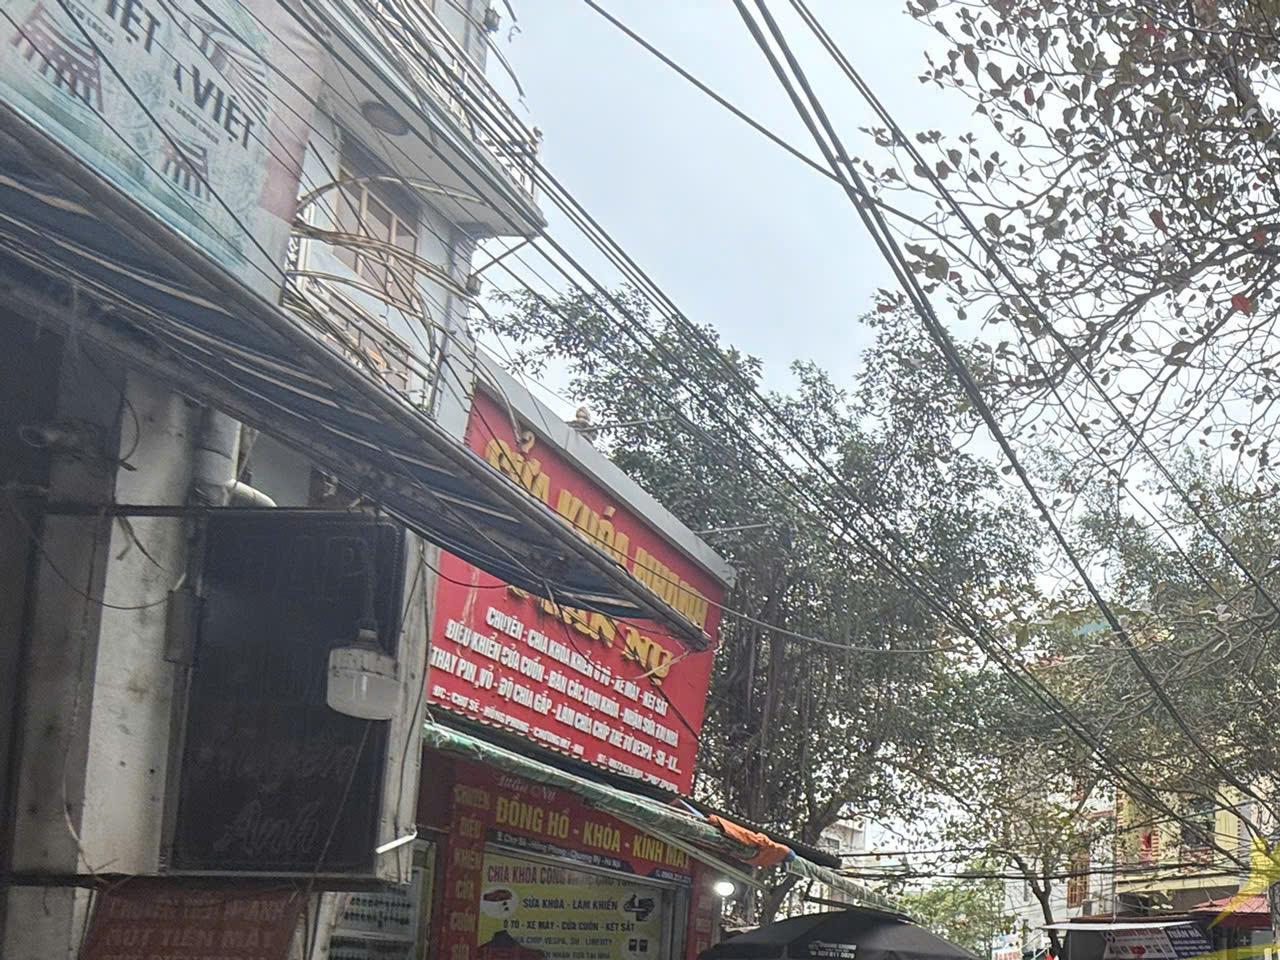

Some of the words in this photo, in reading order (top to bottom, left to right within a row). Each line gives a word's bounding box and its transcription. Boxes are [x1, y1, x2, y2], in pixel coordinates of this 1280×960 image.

[486, 606, 524, 640] CHUYÊN
[430, 646, 457, 674] THAY
[495, 794, 544, 835] ĐỒNG
[547, 808, 570, 839] HỒ
[583, 821, 621, 853] KHÓA
[632, 832, 663, 861] KÍNH
[512, 865, 538, 883] KHÓA
[522, 895, 541, 909] SỬA
